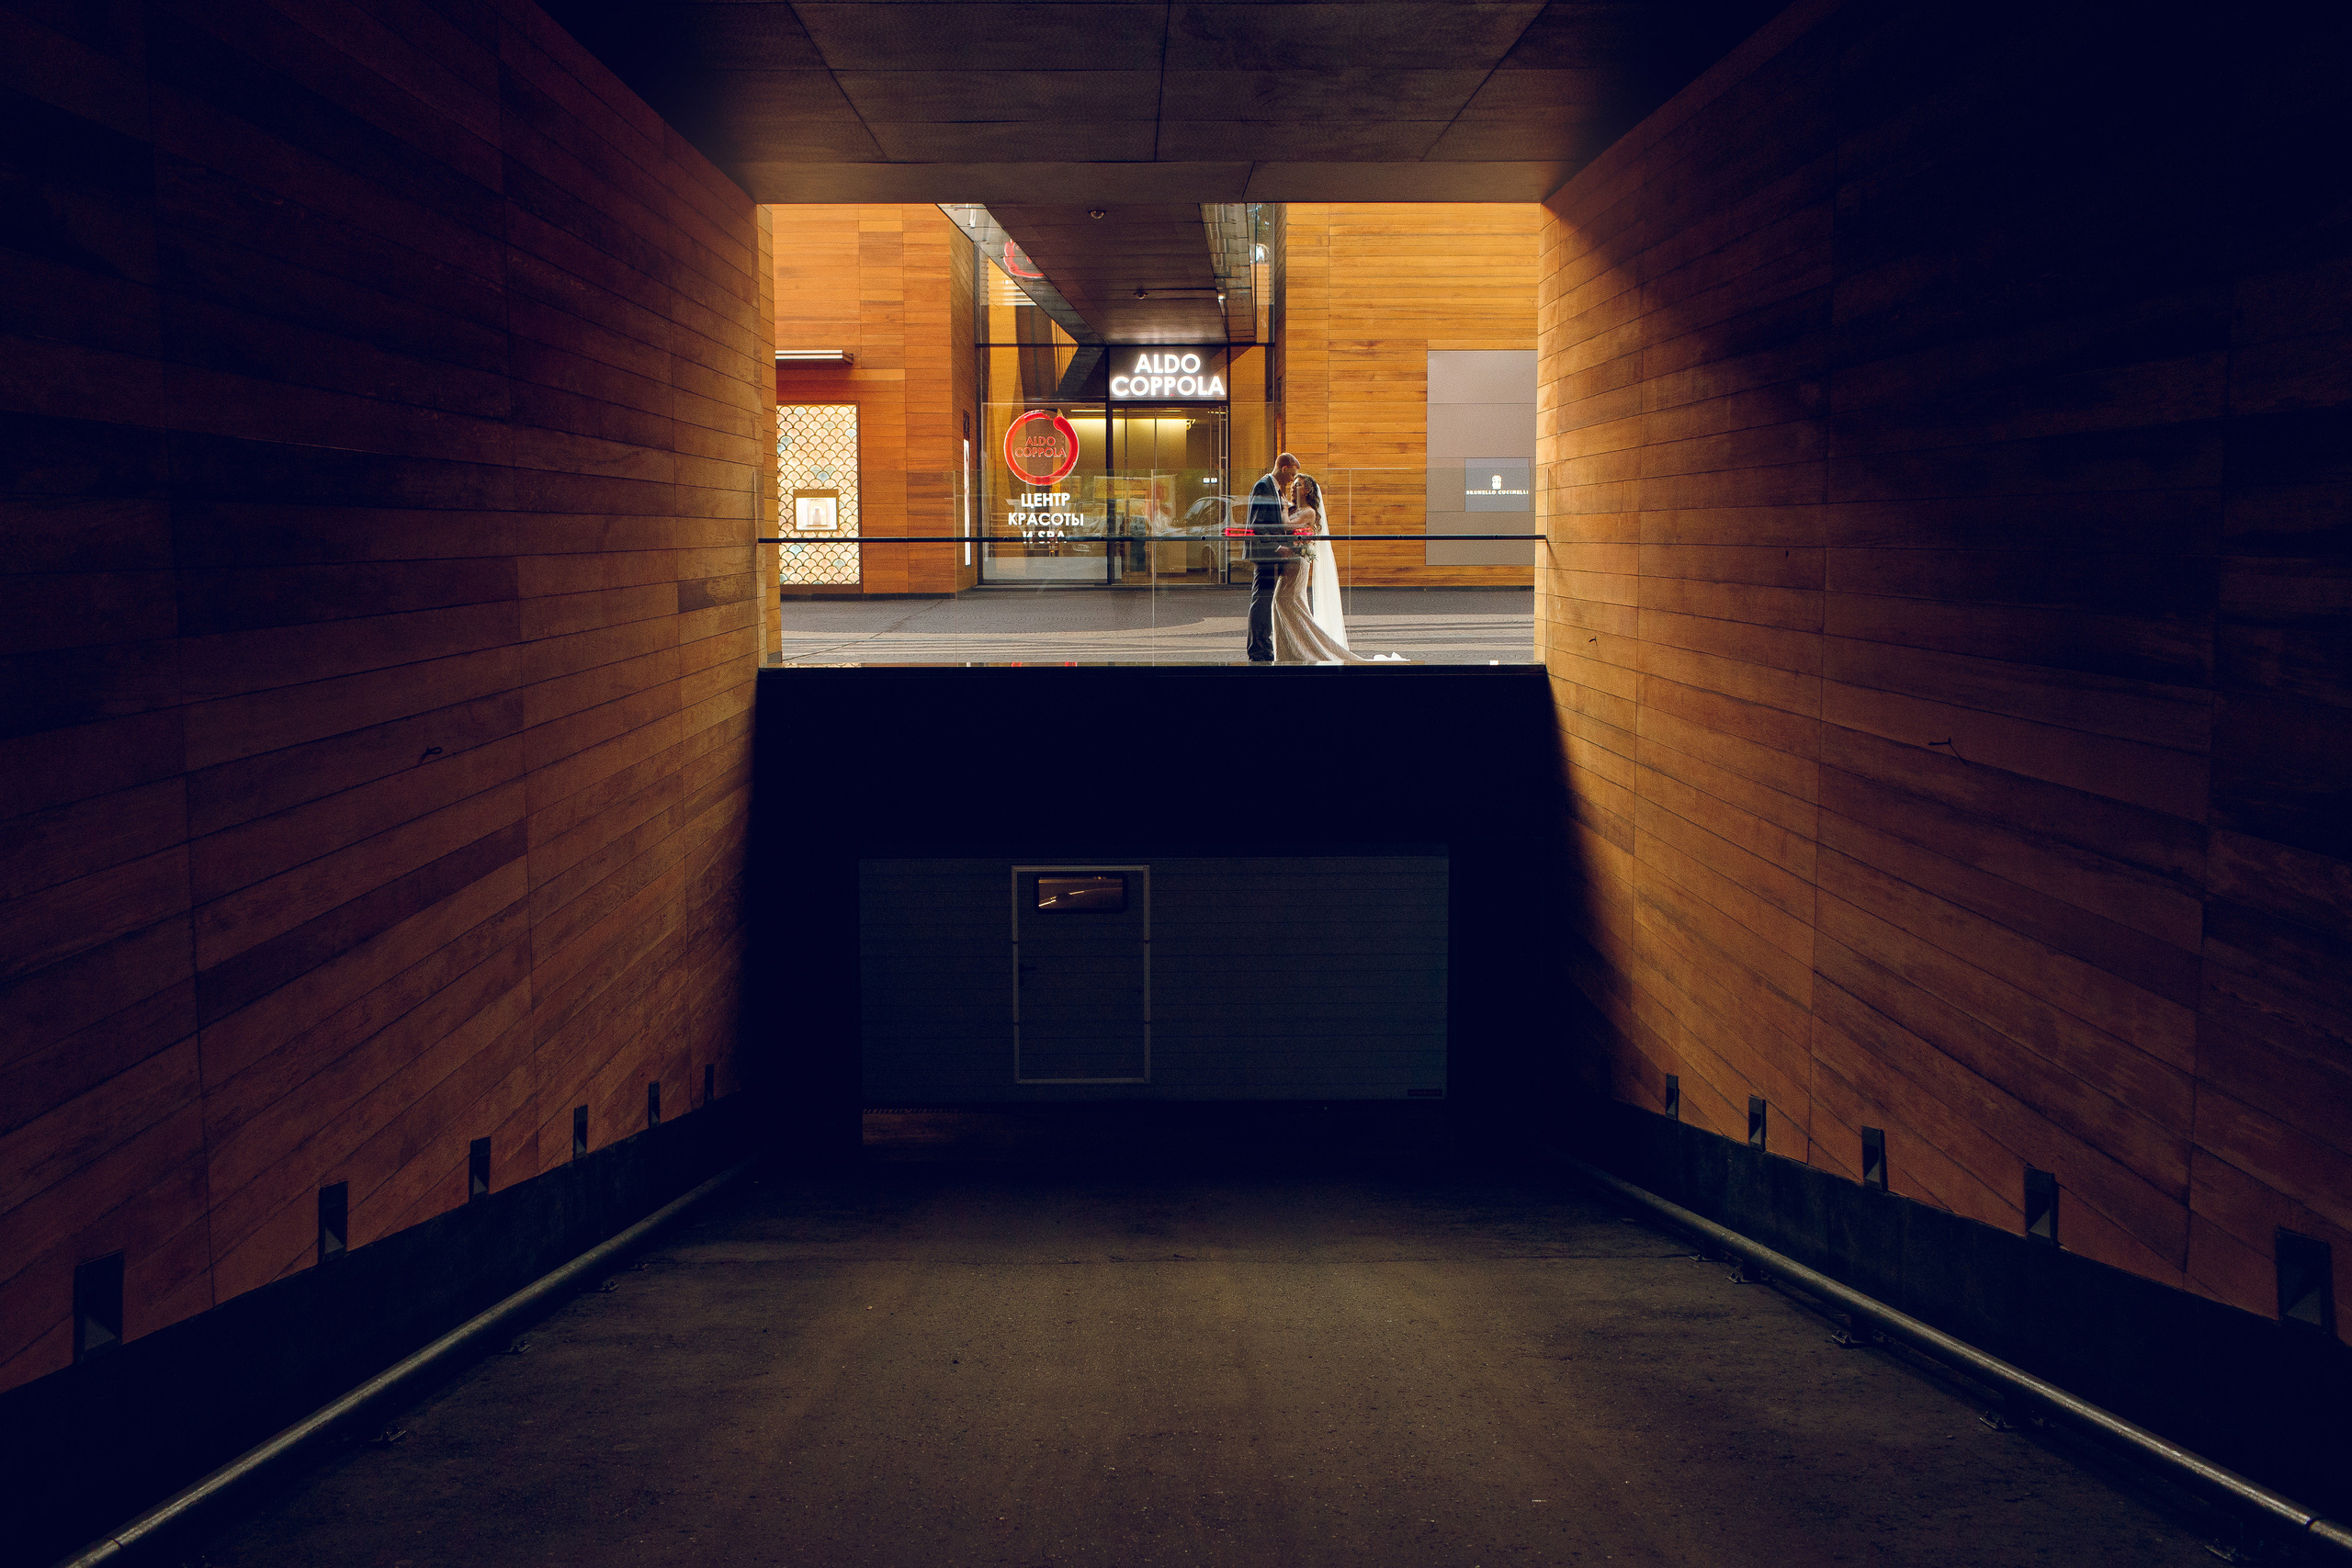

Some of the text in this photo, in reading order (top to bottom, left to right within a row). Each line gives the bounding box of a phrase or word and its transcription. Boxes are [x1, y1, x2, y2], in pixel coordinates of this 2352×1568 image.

[1135, 353, 1201, 374] ALDO
[1111, 376, 1226, 396] COPPOLA
[1024, 435, 1056, 446] ALDO
[1014, 446, 1067, 457] COPPOLA
[1021, 492, 1070, 509] ЦЕНТР
[1008, 513, 1084, 526] КРАСОТЫ
